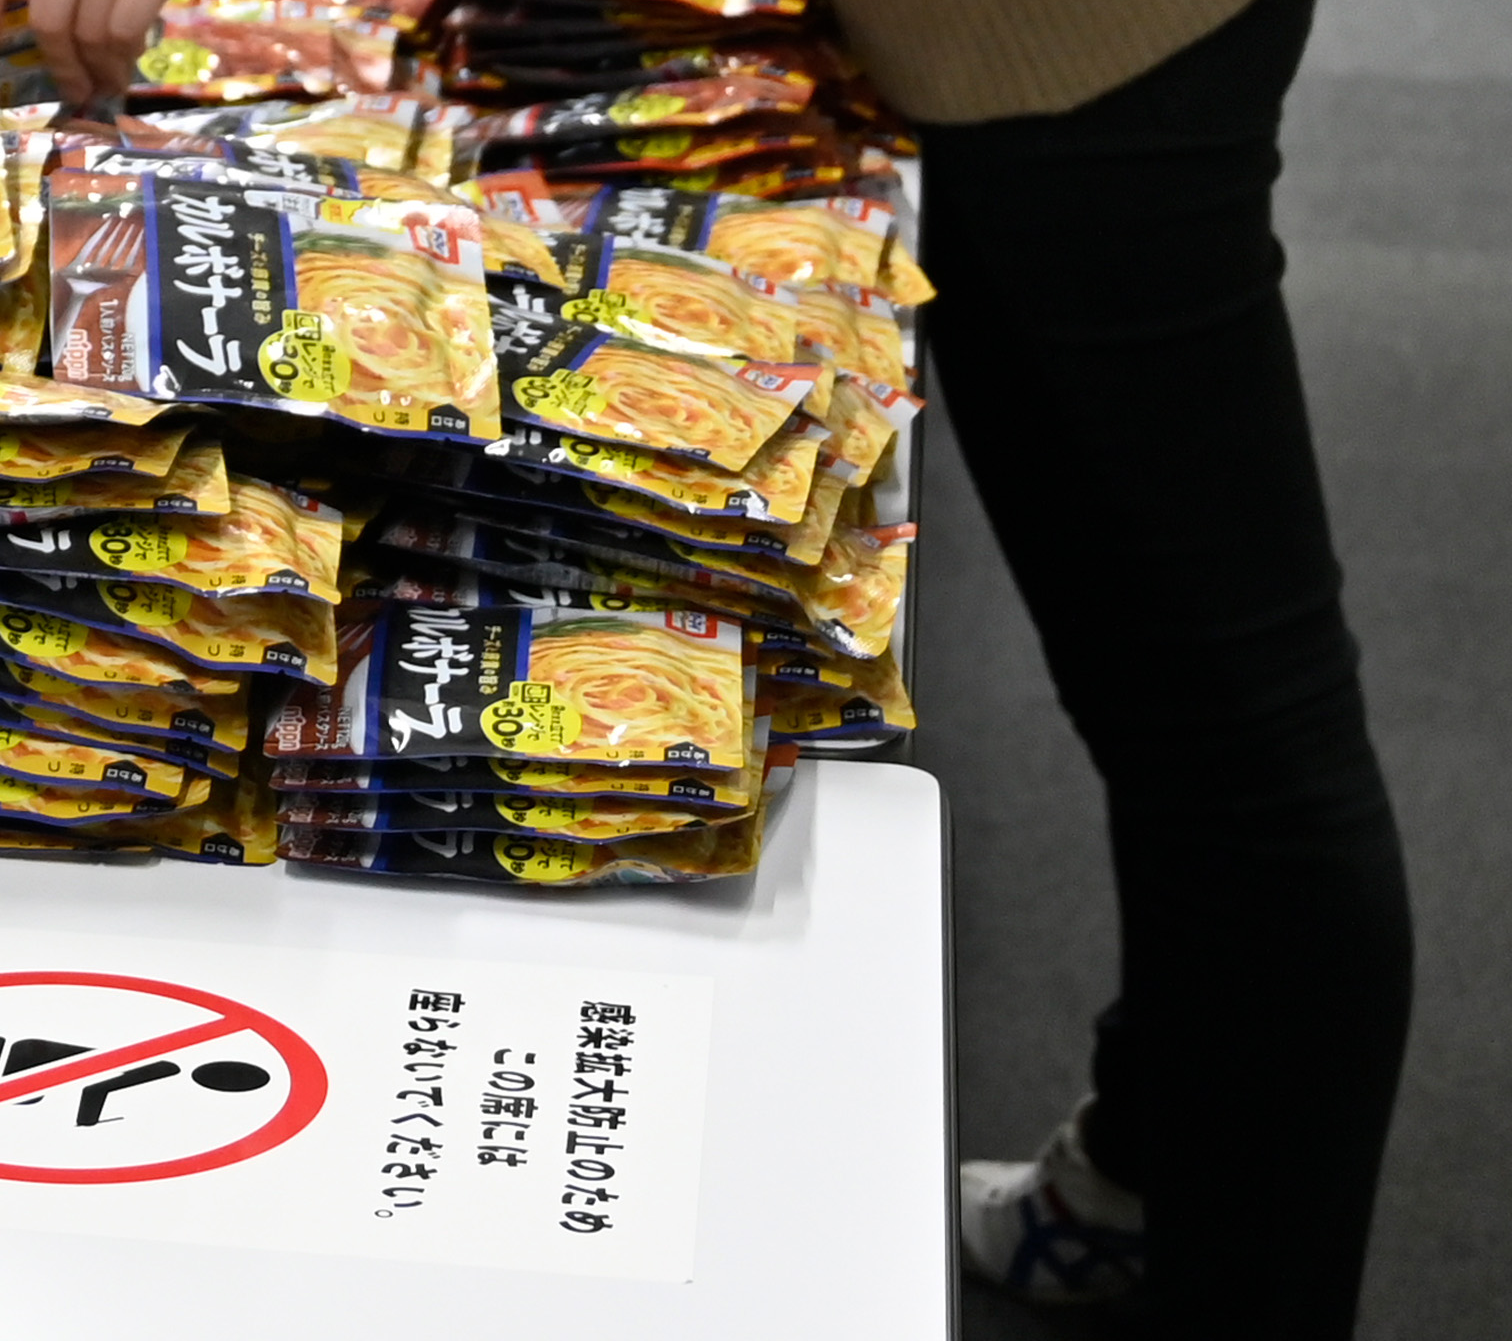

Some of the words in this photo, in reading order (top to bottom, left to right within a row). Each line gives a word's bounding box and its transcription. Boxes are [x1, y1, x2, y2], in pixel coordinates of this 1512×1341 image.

[171, 194, 245, 376] カルボナーラ
[63, 328, 89, 381] nippn
[209, 575, 247, 587] 持つ
[268, 575, 306, 588] あけ口
[208, 643, 246, 658] 持つ
[267, 650, 303, 666] あけ口
[276, 706, 306, 751] nippn
[48, 761, 85, 775] 持つ
[107, 769, 143, 783] あけ口
[374, 989, 466, 1219] 座らないでください。
[477, 1048, 539, 1167] この席には
[559, 1001, 636, 1234] 感染拡大防止のため
